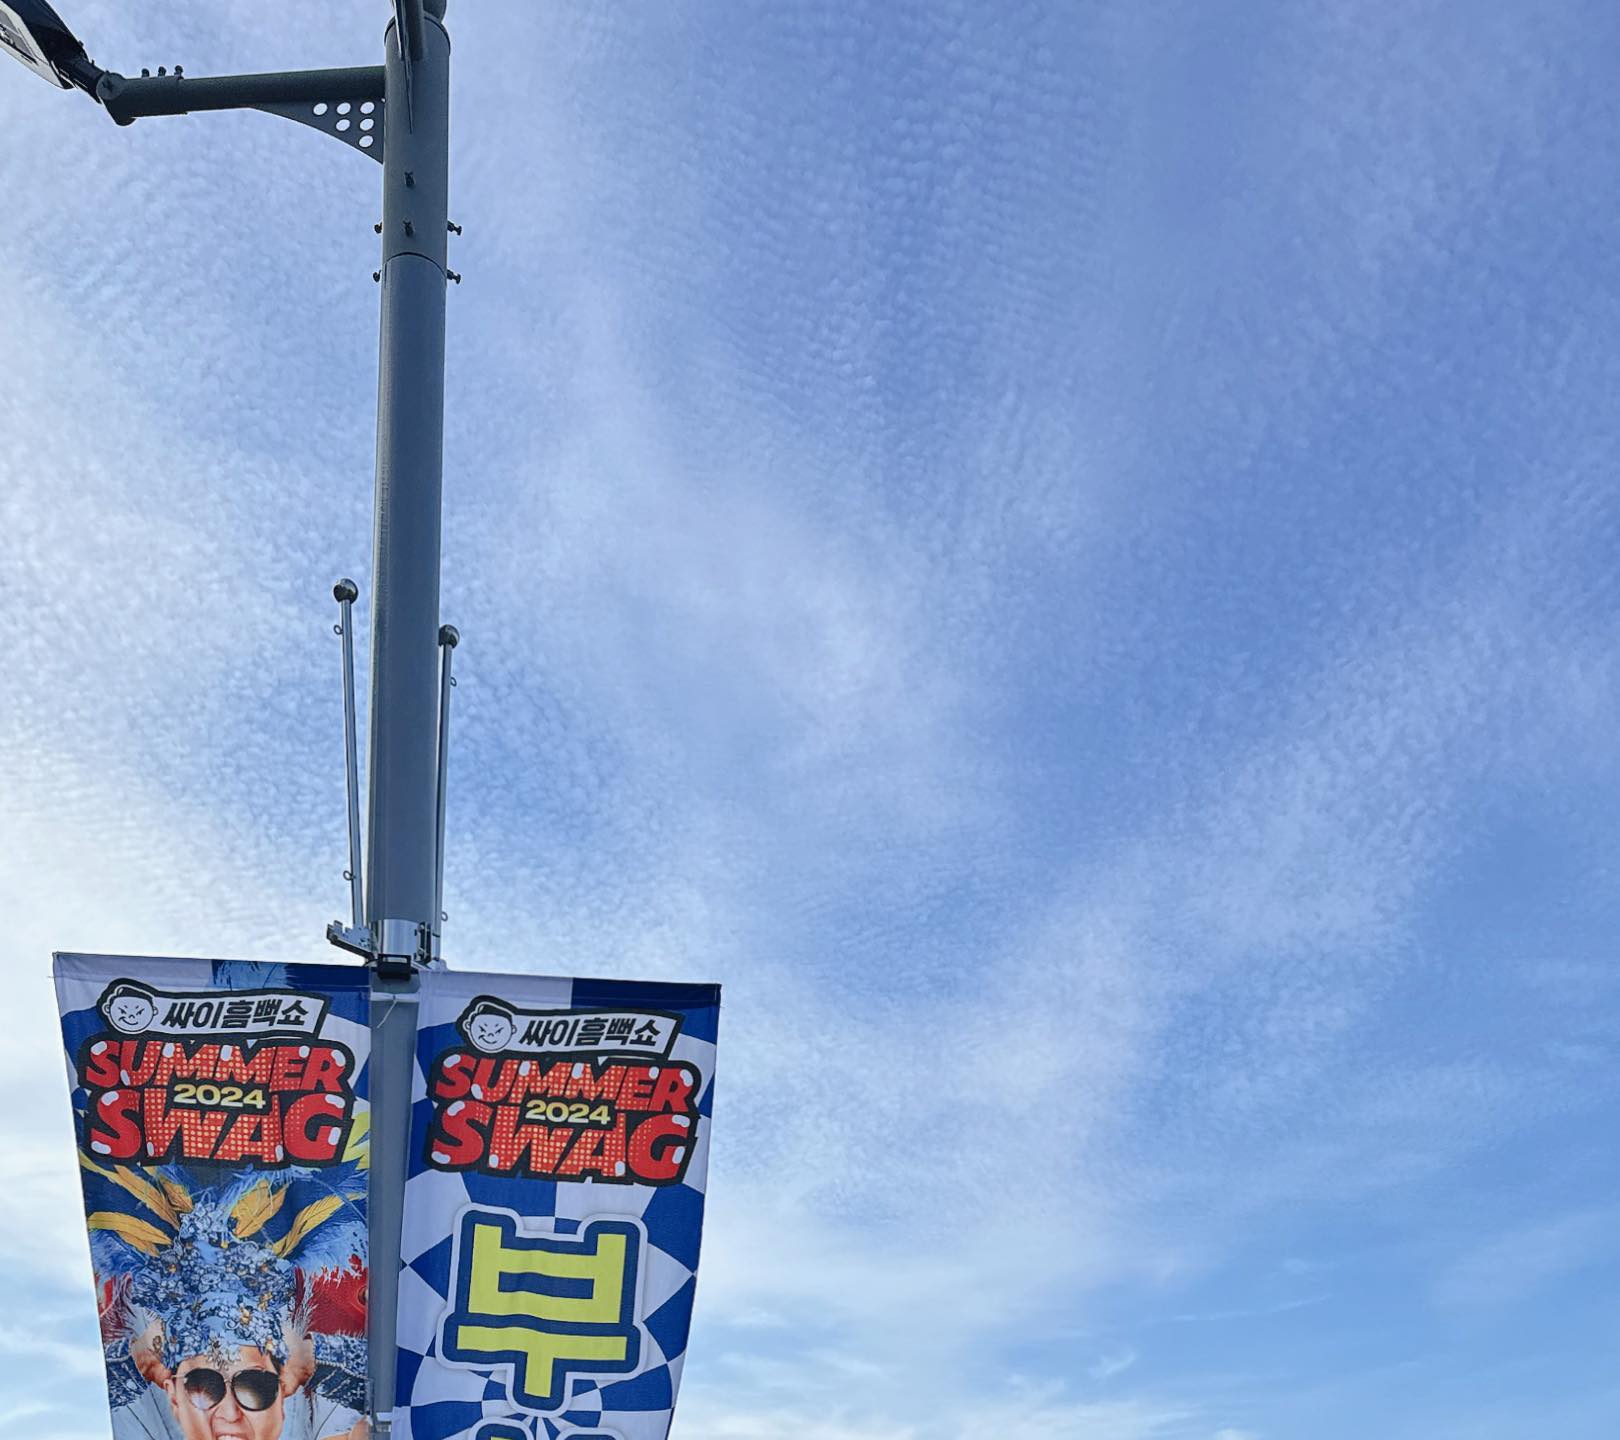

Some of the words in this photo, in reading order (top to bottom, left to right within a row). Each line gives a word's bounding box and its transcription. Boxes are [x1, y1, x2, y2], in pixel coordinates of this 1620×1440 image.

[86, 1040, 346, 1092] SUMMER
[434, 1053, 693, 1112] SUMMER
[173, 1084, 266, 1110] 2024
[525, 1099, 611, 1125] 2024
[90, 1088, 345, 1162] SWAG
[431, 1101, 690, 1180] SWAG
